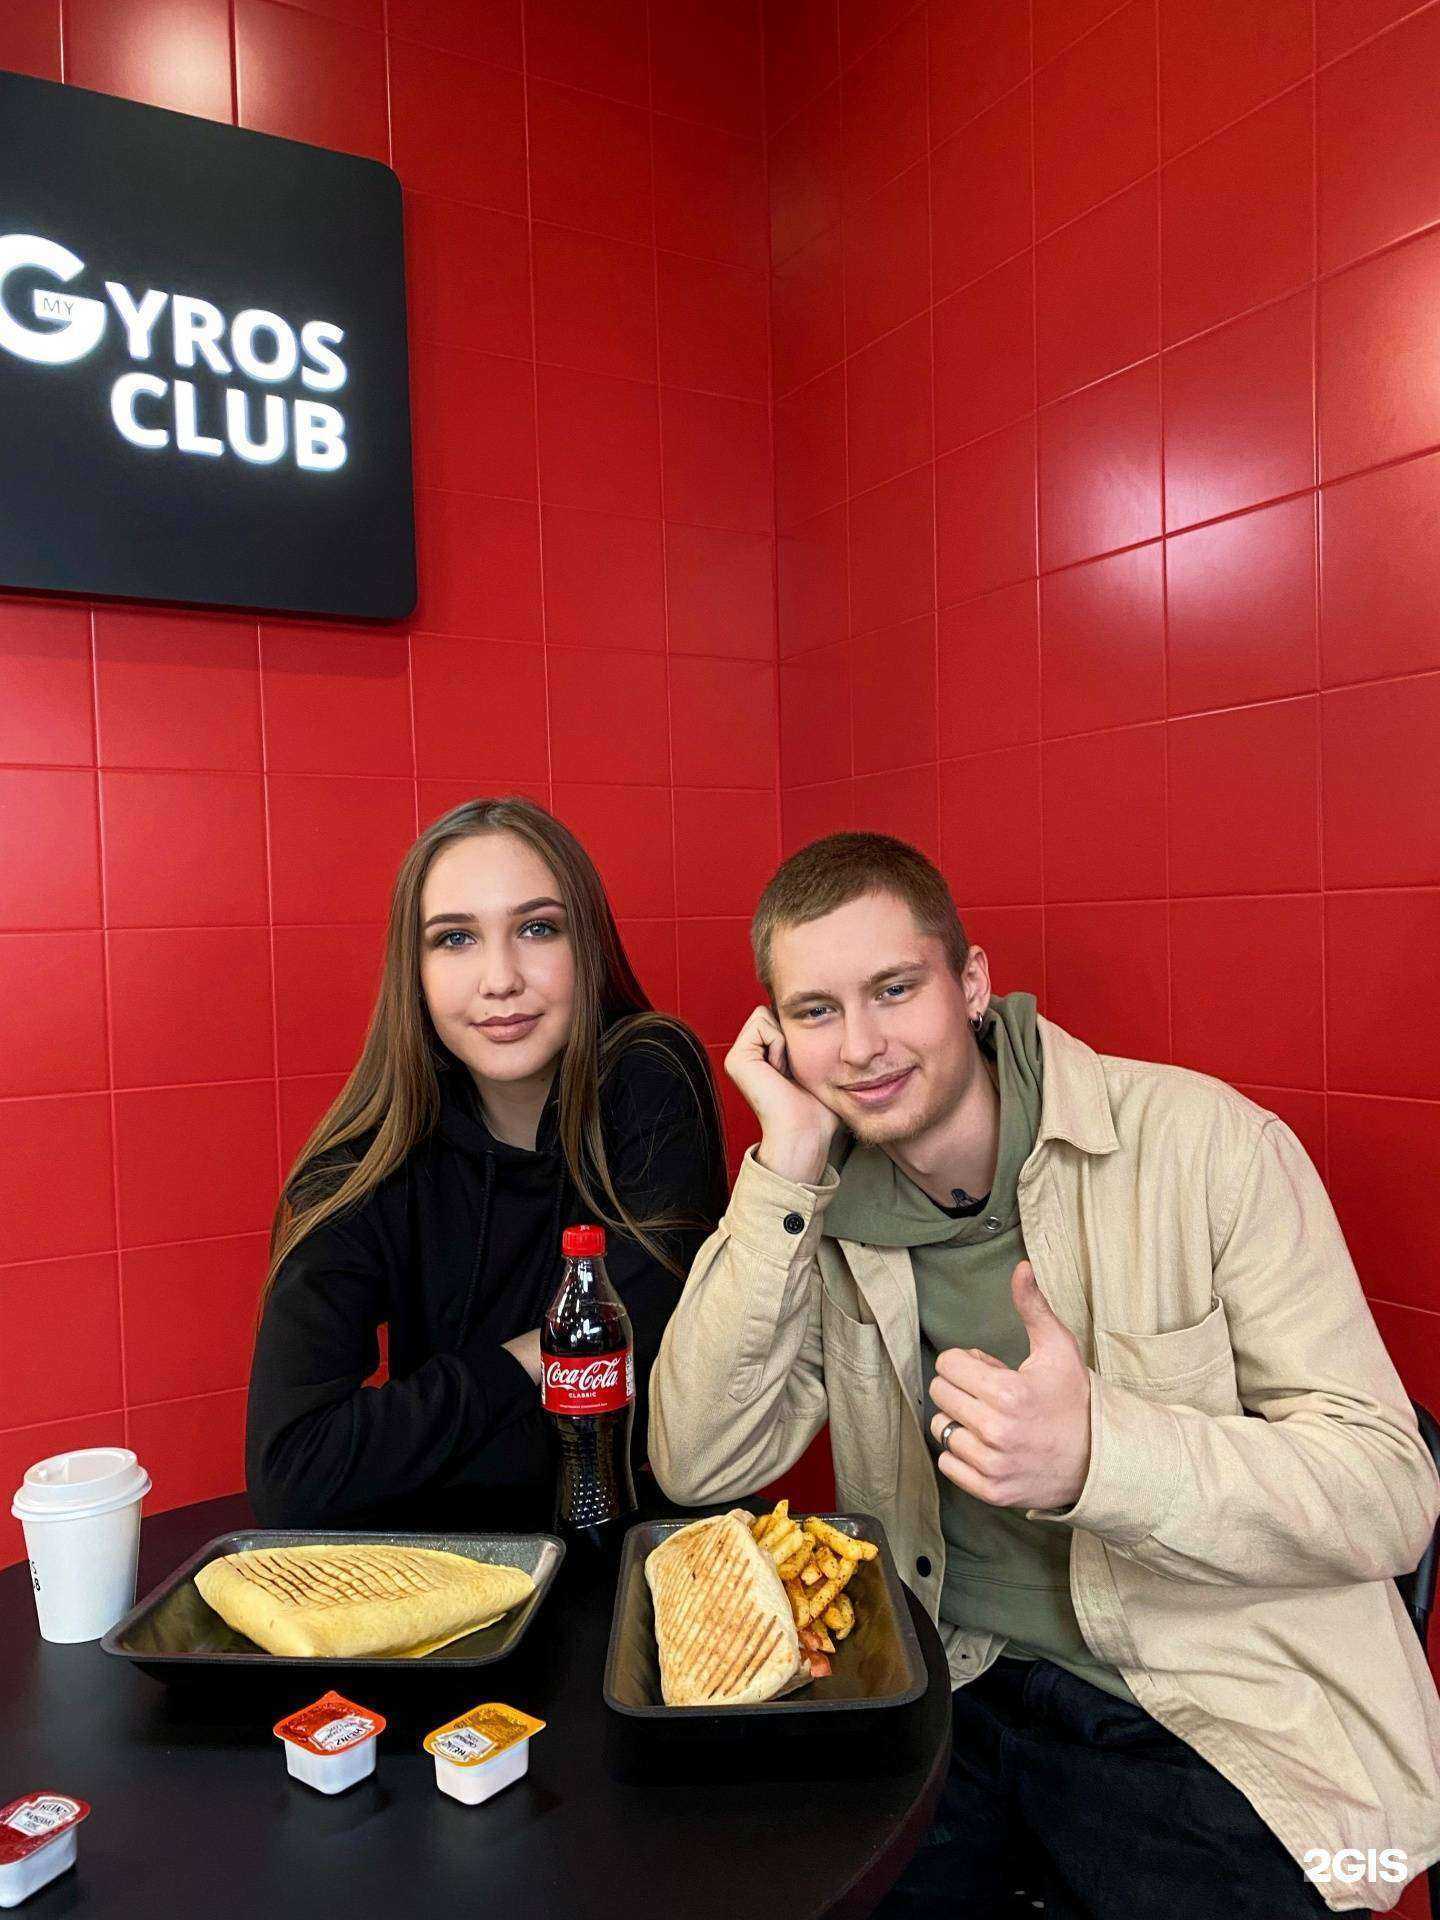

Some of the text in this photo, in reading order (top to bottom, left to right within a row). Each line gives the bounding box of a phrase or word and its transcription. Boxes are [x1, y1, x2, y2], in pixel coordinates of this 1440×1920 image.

[0, 233, 348, 392] GYROS
[43, 297, 75, 316] MY
[110, 372, 348, 471] CLUB
[547, 1357, 622, 1391] Coca-Cola
